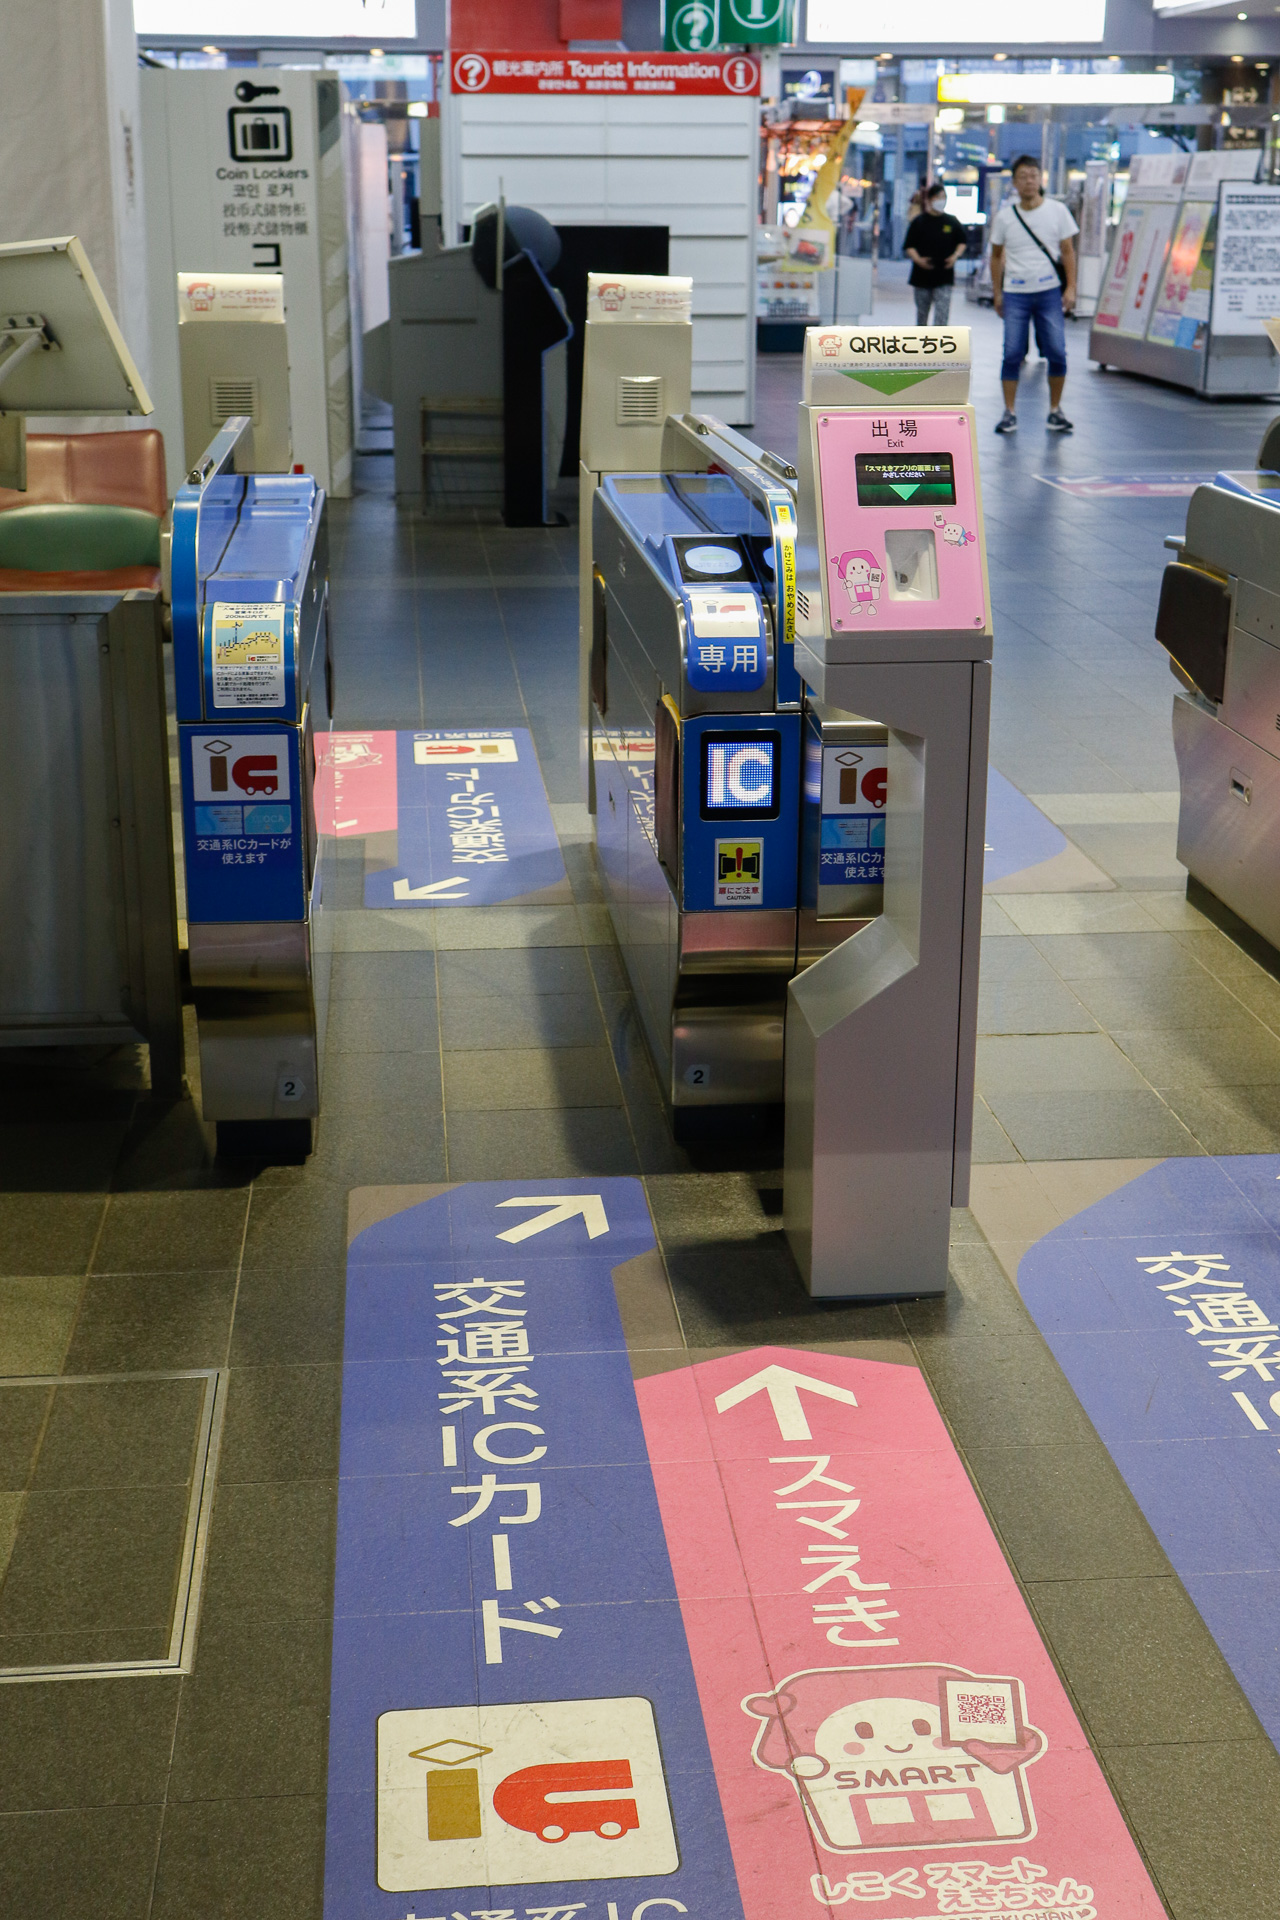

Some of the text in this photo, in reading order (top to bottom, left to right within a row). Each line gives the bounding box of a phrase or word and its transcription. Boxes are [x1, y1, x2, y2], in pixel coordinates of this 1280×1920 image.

[568, 60, 625, 78] Tourist
[628, 61, 721, 79] Information
[216, 167, 309, 180] Coin Lockers
[849, 335, 957, 355] QRはこちら
[871, 419, 918, 438] 出場
[887, 438, 905, 448] Exit
[882, 471, 926, 479] かざしてください
[786, 585, 795, 640] おやめください
[697, 645, 758, 674] 専用
[711, 749, 771, 802] IC
[197, 838, 292, 851] 交通系ICカードが
[221, 853, 268, 865] 使えます
[821, 852, 885, 864] 交通系ICカ
[719, 886, 760, 895] 扉にご注意
[692, 1069, 705, 1084] 2
[284, 1081, 296, 1097] 2
[433, 1277, 564, 1664] 交通系ICカード
[768, 1455, 901, 1648] スマえき
[835, 1763, 981, 1791] SMART
[812, 1857, 1046, 1904] しこく スマート
[939, 1878, 1094, 1912] えきちゃん
